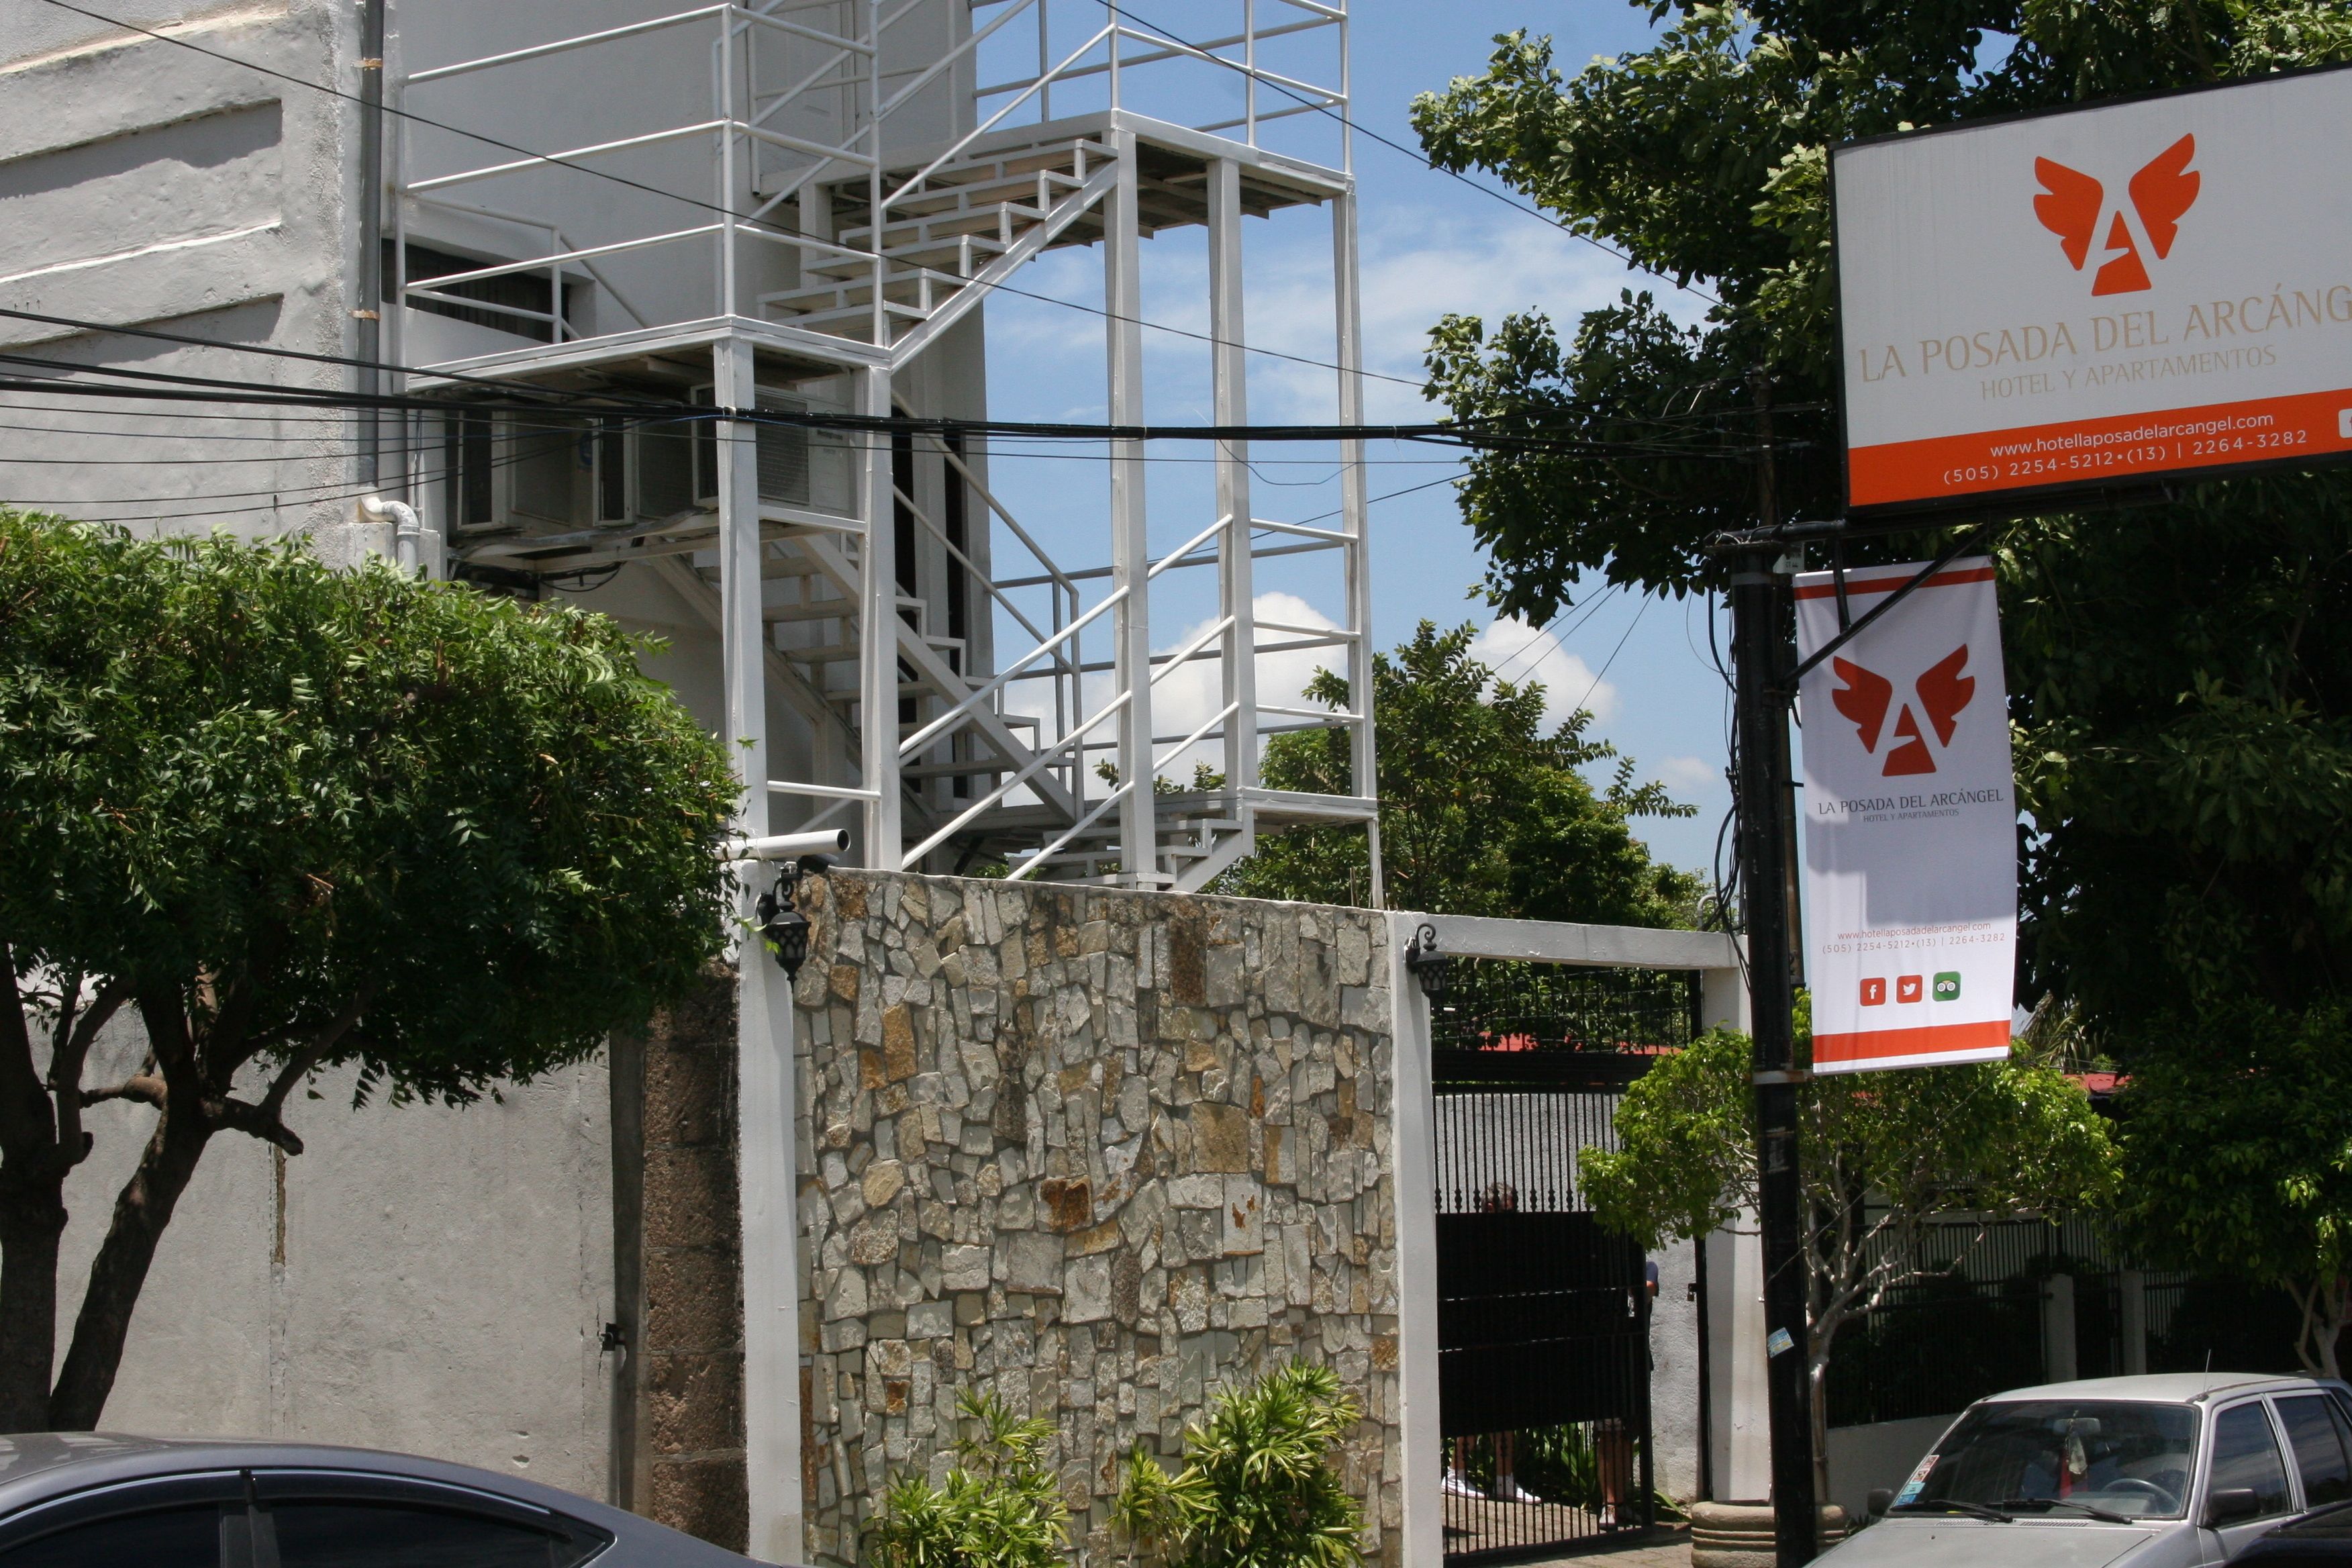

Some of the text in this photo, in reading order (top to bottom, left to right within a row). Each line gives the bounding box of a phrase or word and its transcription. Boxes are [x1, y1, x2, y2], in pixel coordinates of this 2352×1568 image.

[1859, 344, 1907, 383] LA
[1918, 322, 2078, 374] POSADA
[2090, 310, 2169, 352] DEL
[1981, 344, 2277, 400] HOTEL Y APARTAMENTOS
[1990, 414, 2273, 457] www.hotellaposadelarcangel.com
[1944, 465, 1998, 485] (505)
[2193, 430, 2307, 455] 2264-3282
[1818, 788, 2004, 814] LA POSADA DEL ARCÁNGEL
[1863, 809, 1959, 822] HOTEL Y APARTAMENTOS
[1822, 944, 1851, 954] (505)
[1949, 933, 2005, 945] 2264-3282
[1838, 922, 1991, 940] www.hotellaposadadelarcangelcom
